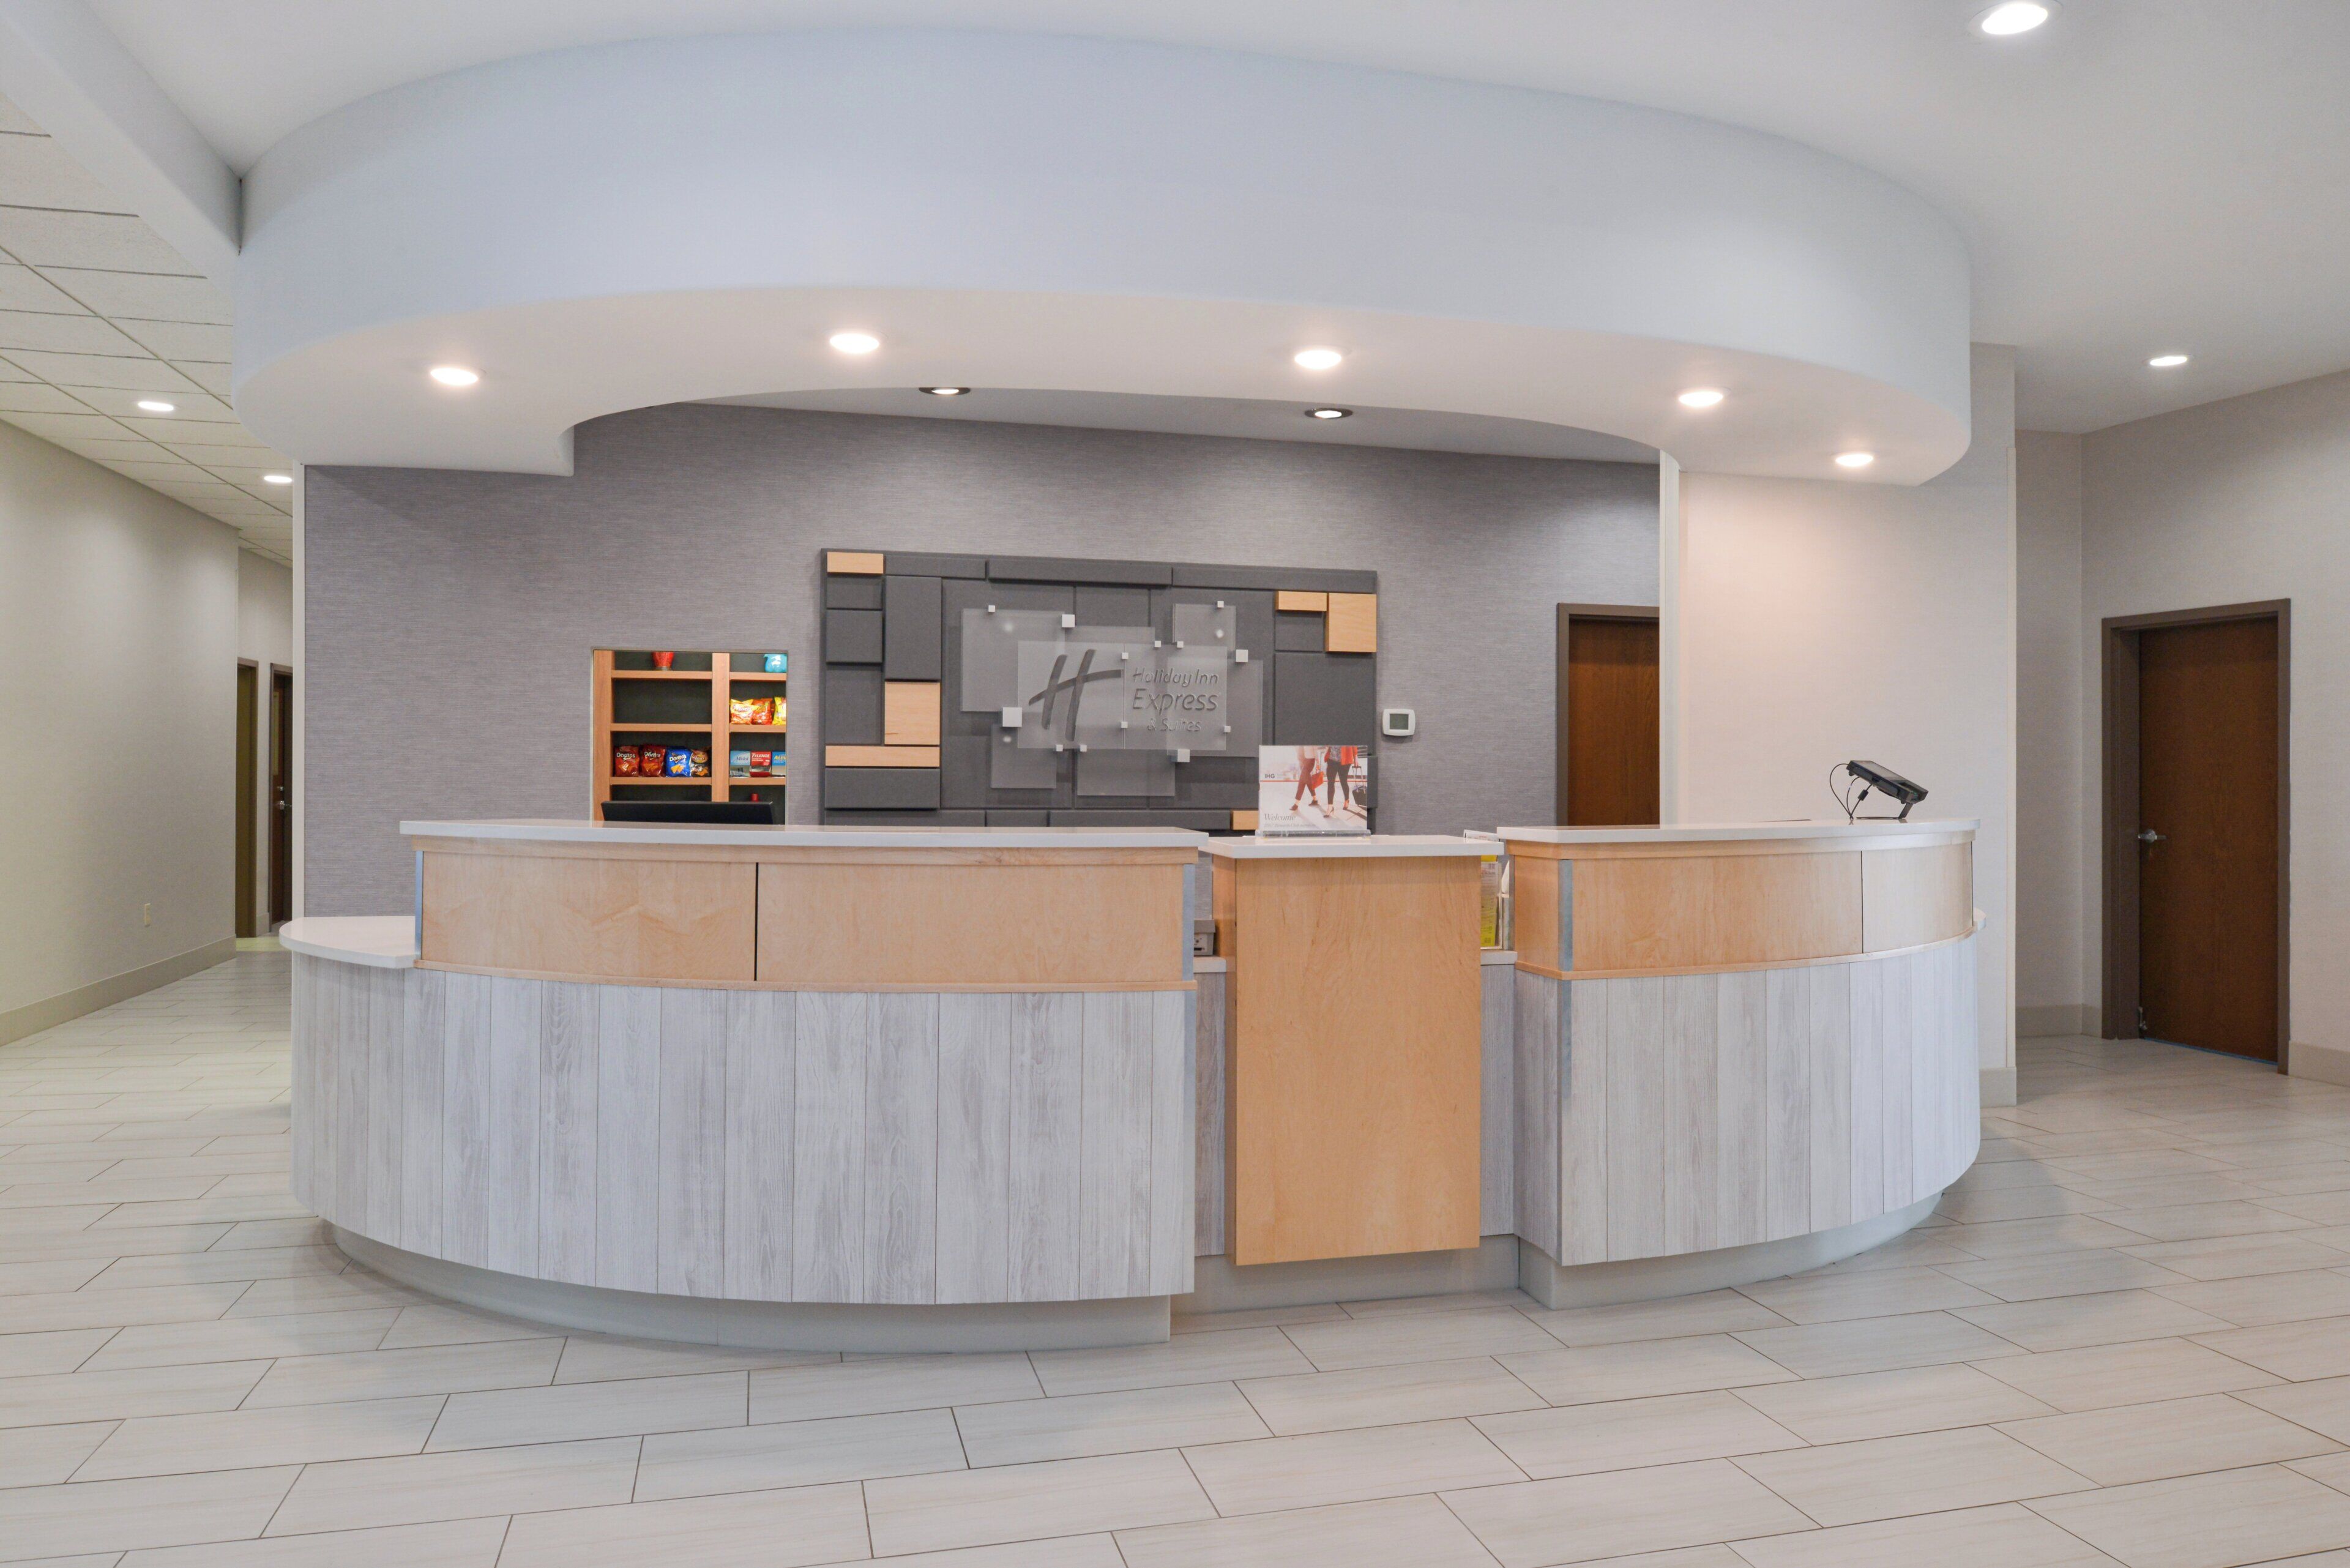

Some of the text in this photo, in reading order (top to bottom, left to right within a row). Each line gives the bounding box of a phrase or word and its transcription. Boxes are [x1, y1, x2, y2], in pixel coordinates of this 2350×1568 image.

[1132, 667, 1219, 687] Holiday Inn
[1132, 688, 1218, 715] Express
[1147, 718, 1202, 732] & Suites
[669, 753, 687, 762] Doritos
